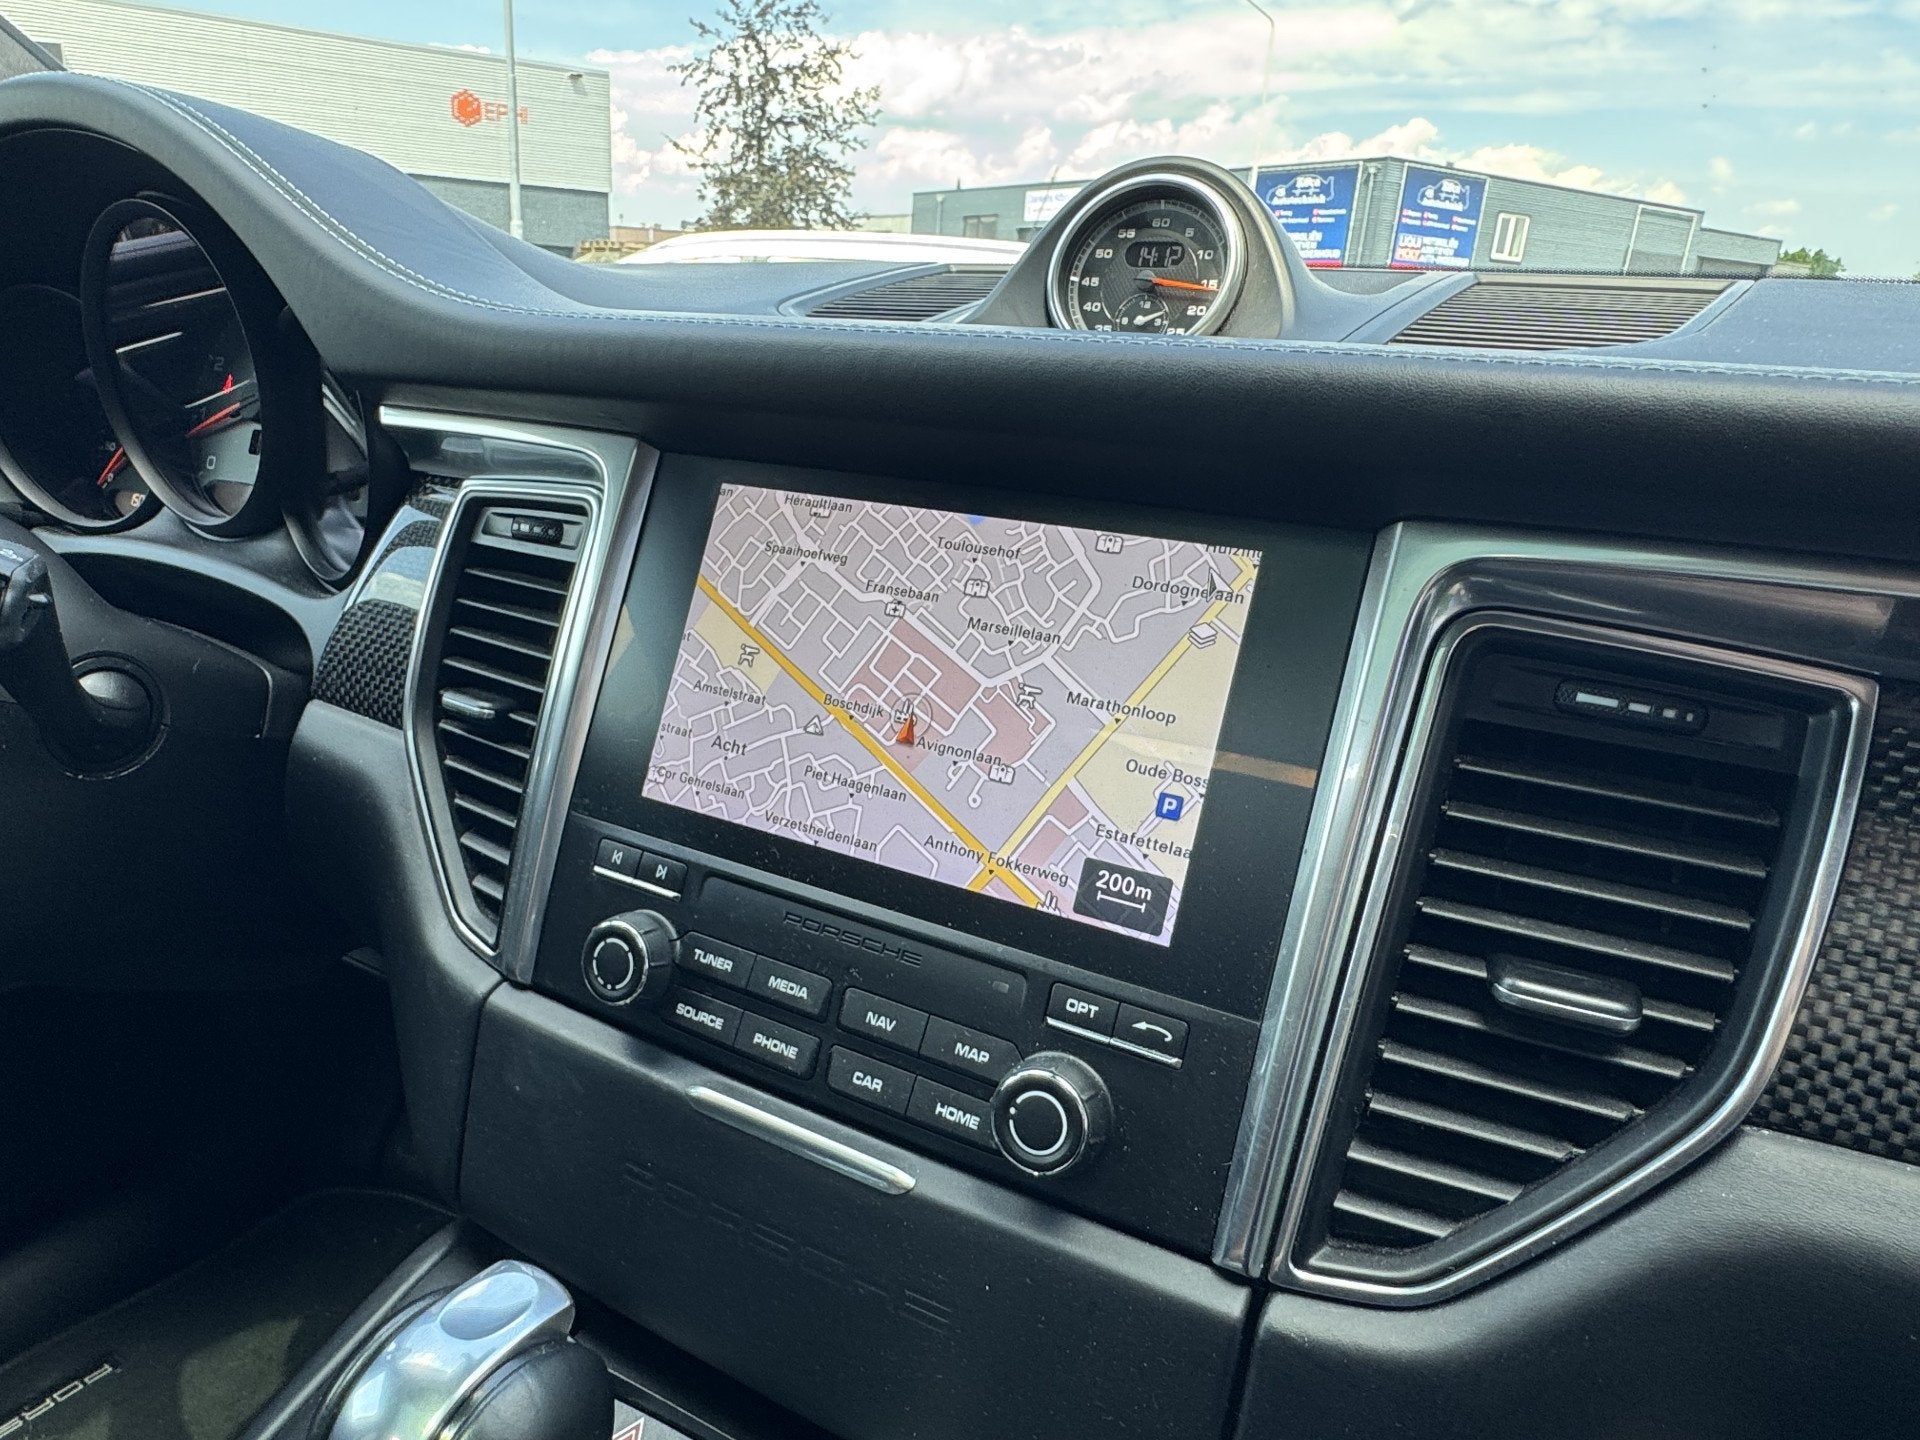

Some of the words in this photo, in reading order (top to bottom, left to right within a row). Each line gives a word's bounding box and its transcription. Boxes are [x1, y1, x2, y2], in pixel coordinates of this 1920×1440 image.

[1118, 229, 1136, 239] 55
[1152, 218, 1171, 228] 60
[1185, 228, 1195, 238] 5
[1095, 249, 1113, 259] 50
[1197, 250, 1214, 260] 10
[1081, 277, 1100, 287] 45
[1083, 302, 1101, 312] 40
[1186, 306, 1207, 316] 20
[207, 455, 216, 470] 0
[764, 541, 848, 567] Spaaihoefweg
[936, 536, 1021, 560] Toulousehof
[866, 580, 940, 604] Fransebaan
[1132, 576, 1244, 605] Dordogneaan
[967, 616, 1061, 644] Marseillelaan
[693, 680, 767, 707] Amstelstraat
[824, 694, 884, 718] Boschdijk
[1067, 691, 1177, 726] Marathonloop
[711, 735, 747, 756] Acht
[917, 736, 1002, 765] Avignonlaan
[804, 765, 829, 786] Piet
[1126, 758, 1167, 780] Oude
[765, 810, 878, 852] Verzetsheldenlaan
[924, 835, 984, 864] Anthony
[988, 851, 1069, 887] Fokkerweg
[1096, 869, 1152, 901] 200m
[783, 910, 922, 968] PORSCHE
[694, 948, 734, 972] TUNER
[768, 975, 808, 1000] MEDIA
[675, 1002, 725, 1030] SOURCE
[1065, 998, 1100, 1019] OPT
[865, 1011, 897, 1032] NAV
[753, 1033, 798, 1059] PHONE
[955, 1042, 990, 1065] MAP
[852, 1071, 883, 1093] CAR
[935, 1102, 981, 1131] HOME
